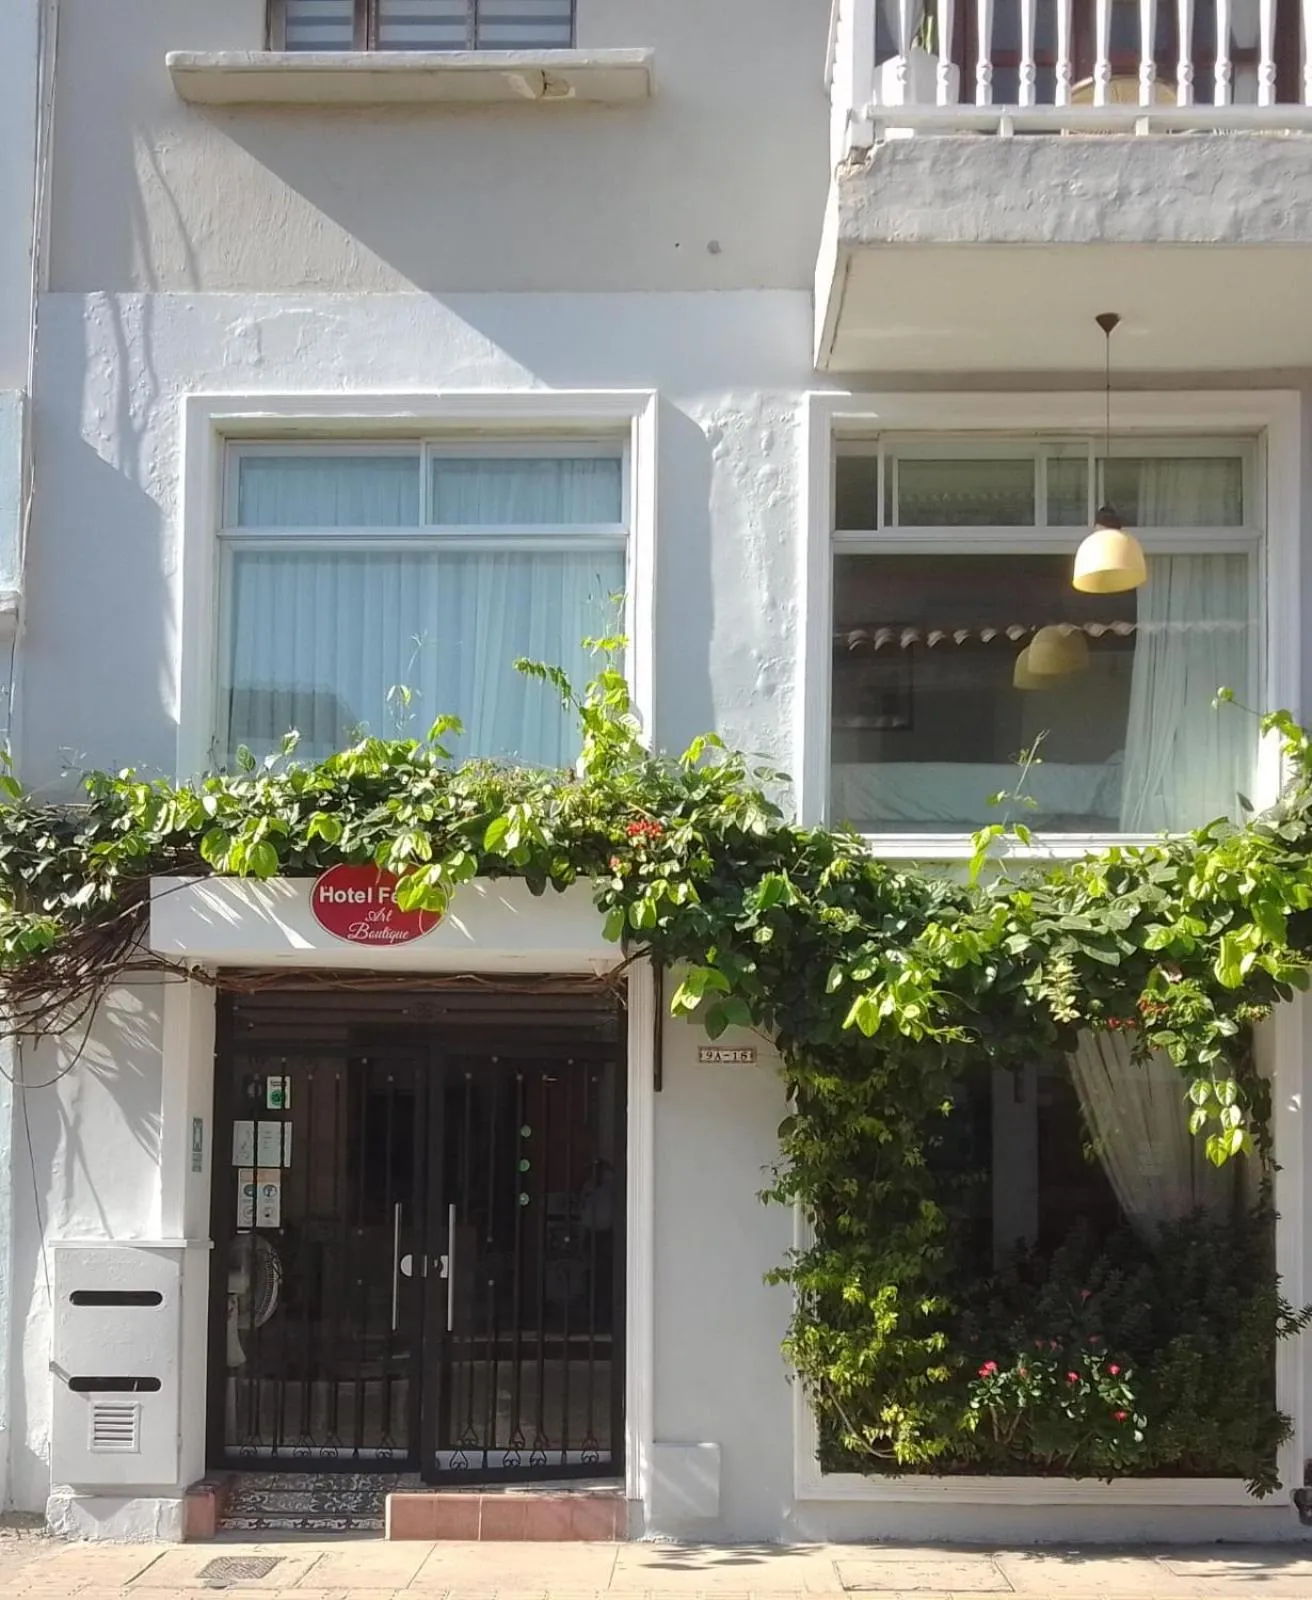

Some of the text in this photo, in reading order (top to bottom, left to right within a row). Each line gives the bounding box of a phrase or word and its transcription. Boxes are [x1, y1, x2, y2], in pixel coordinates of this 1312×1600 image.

[319, 886, 372, 904] Hotel
[365, 907, 392, 922] Art
[348, 922, 409, 943] Boutique
